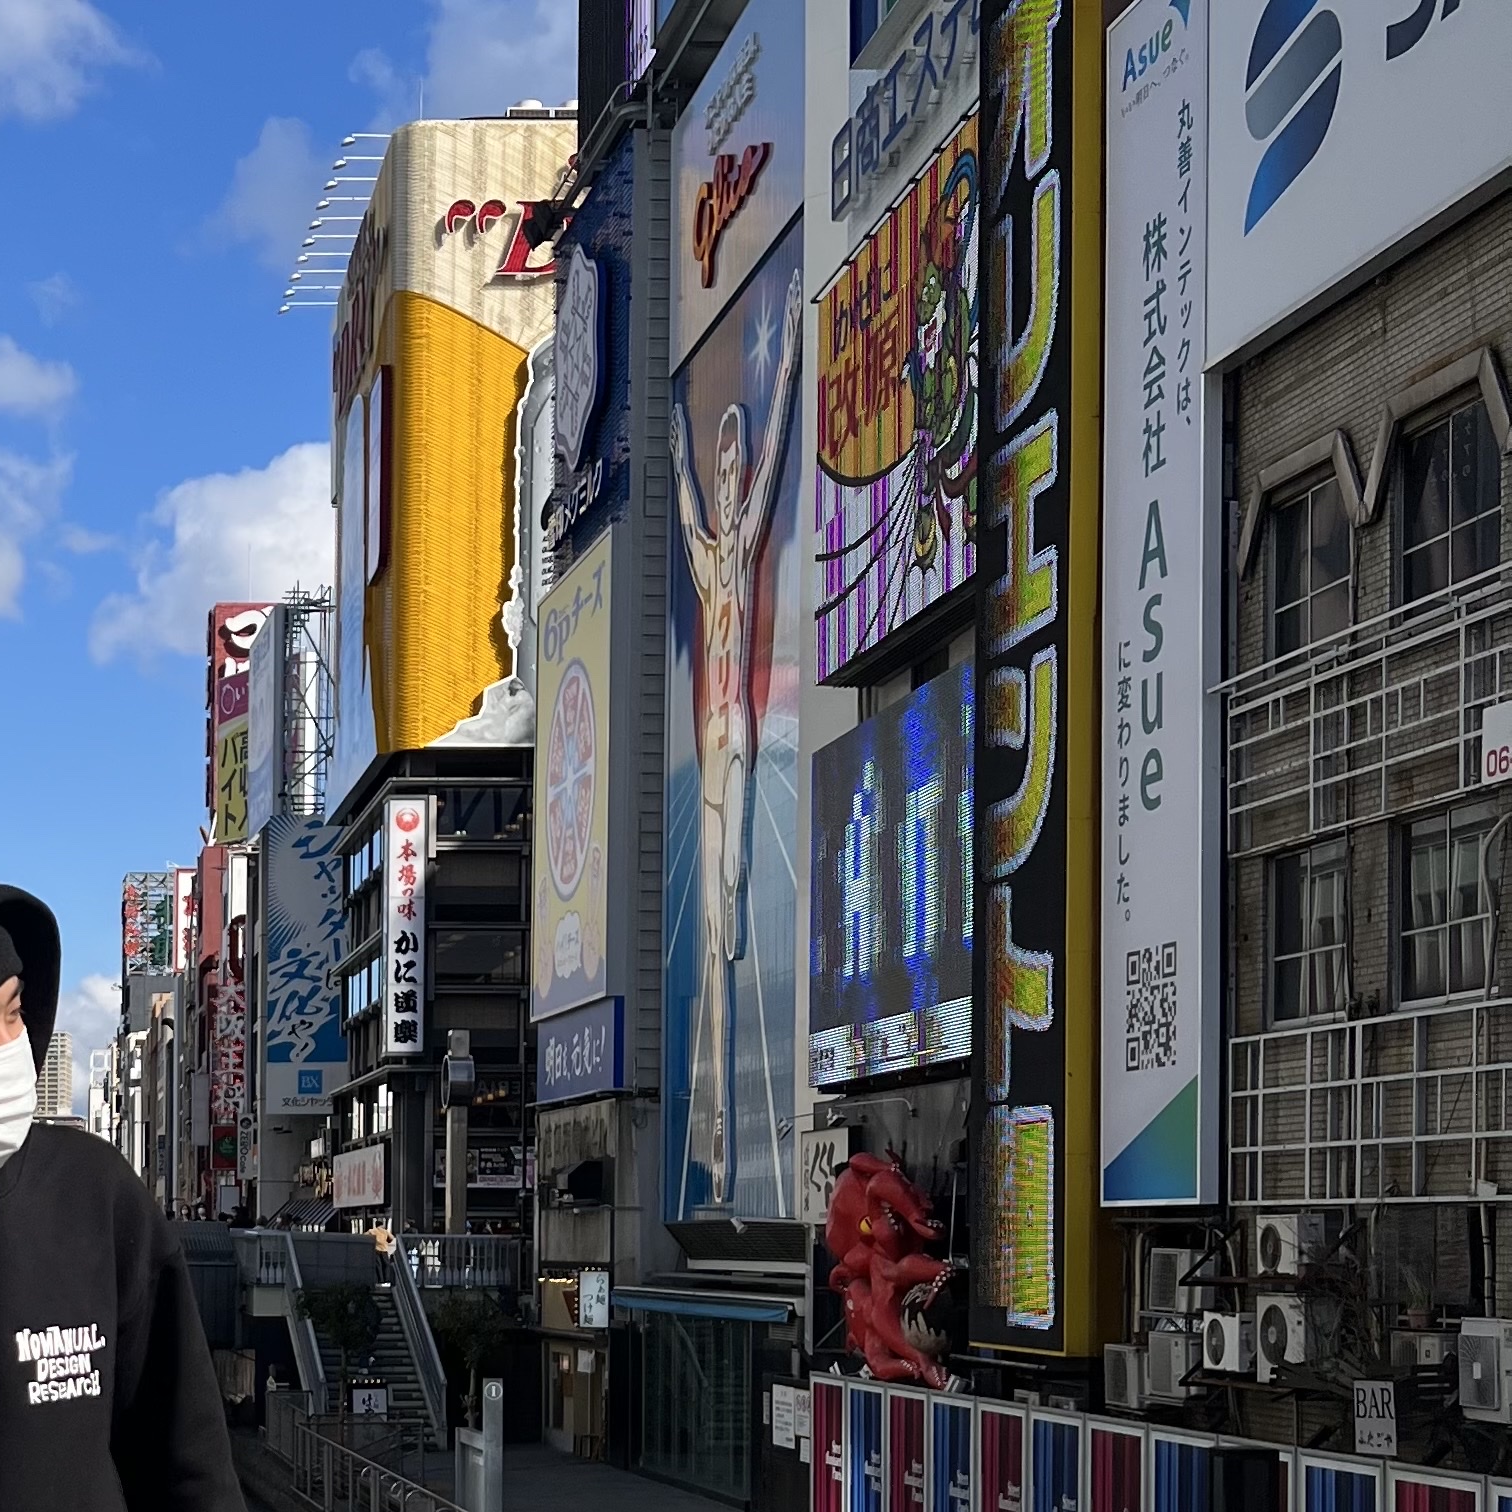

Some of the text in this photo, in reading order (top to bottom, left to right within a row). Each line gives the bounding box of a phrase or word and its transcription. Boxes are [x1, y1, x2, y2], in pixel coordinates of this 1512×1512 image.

[1121, 18, 1173, 93] Asue
[693, 142, 772, 289] Glico
[1176, 98, 1194, 428] 丸善インテックは、
[1142, 212, 1169, 480] 株式会社
[718, 589, 733, 751] グリコ
[221, 737, 238, 836] バイト
[1117, 640, 1132, 922] に変わりました。
[393, 838, 420, 1044] 本場の味 かに道楽
[301, 1076, 320, 1088] BX
[37, 1353, 92, 1382] DESIGN
[1355, 1387, 1395, 1420] BAR
